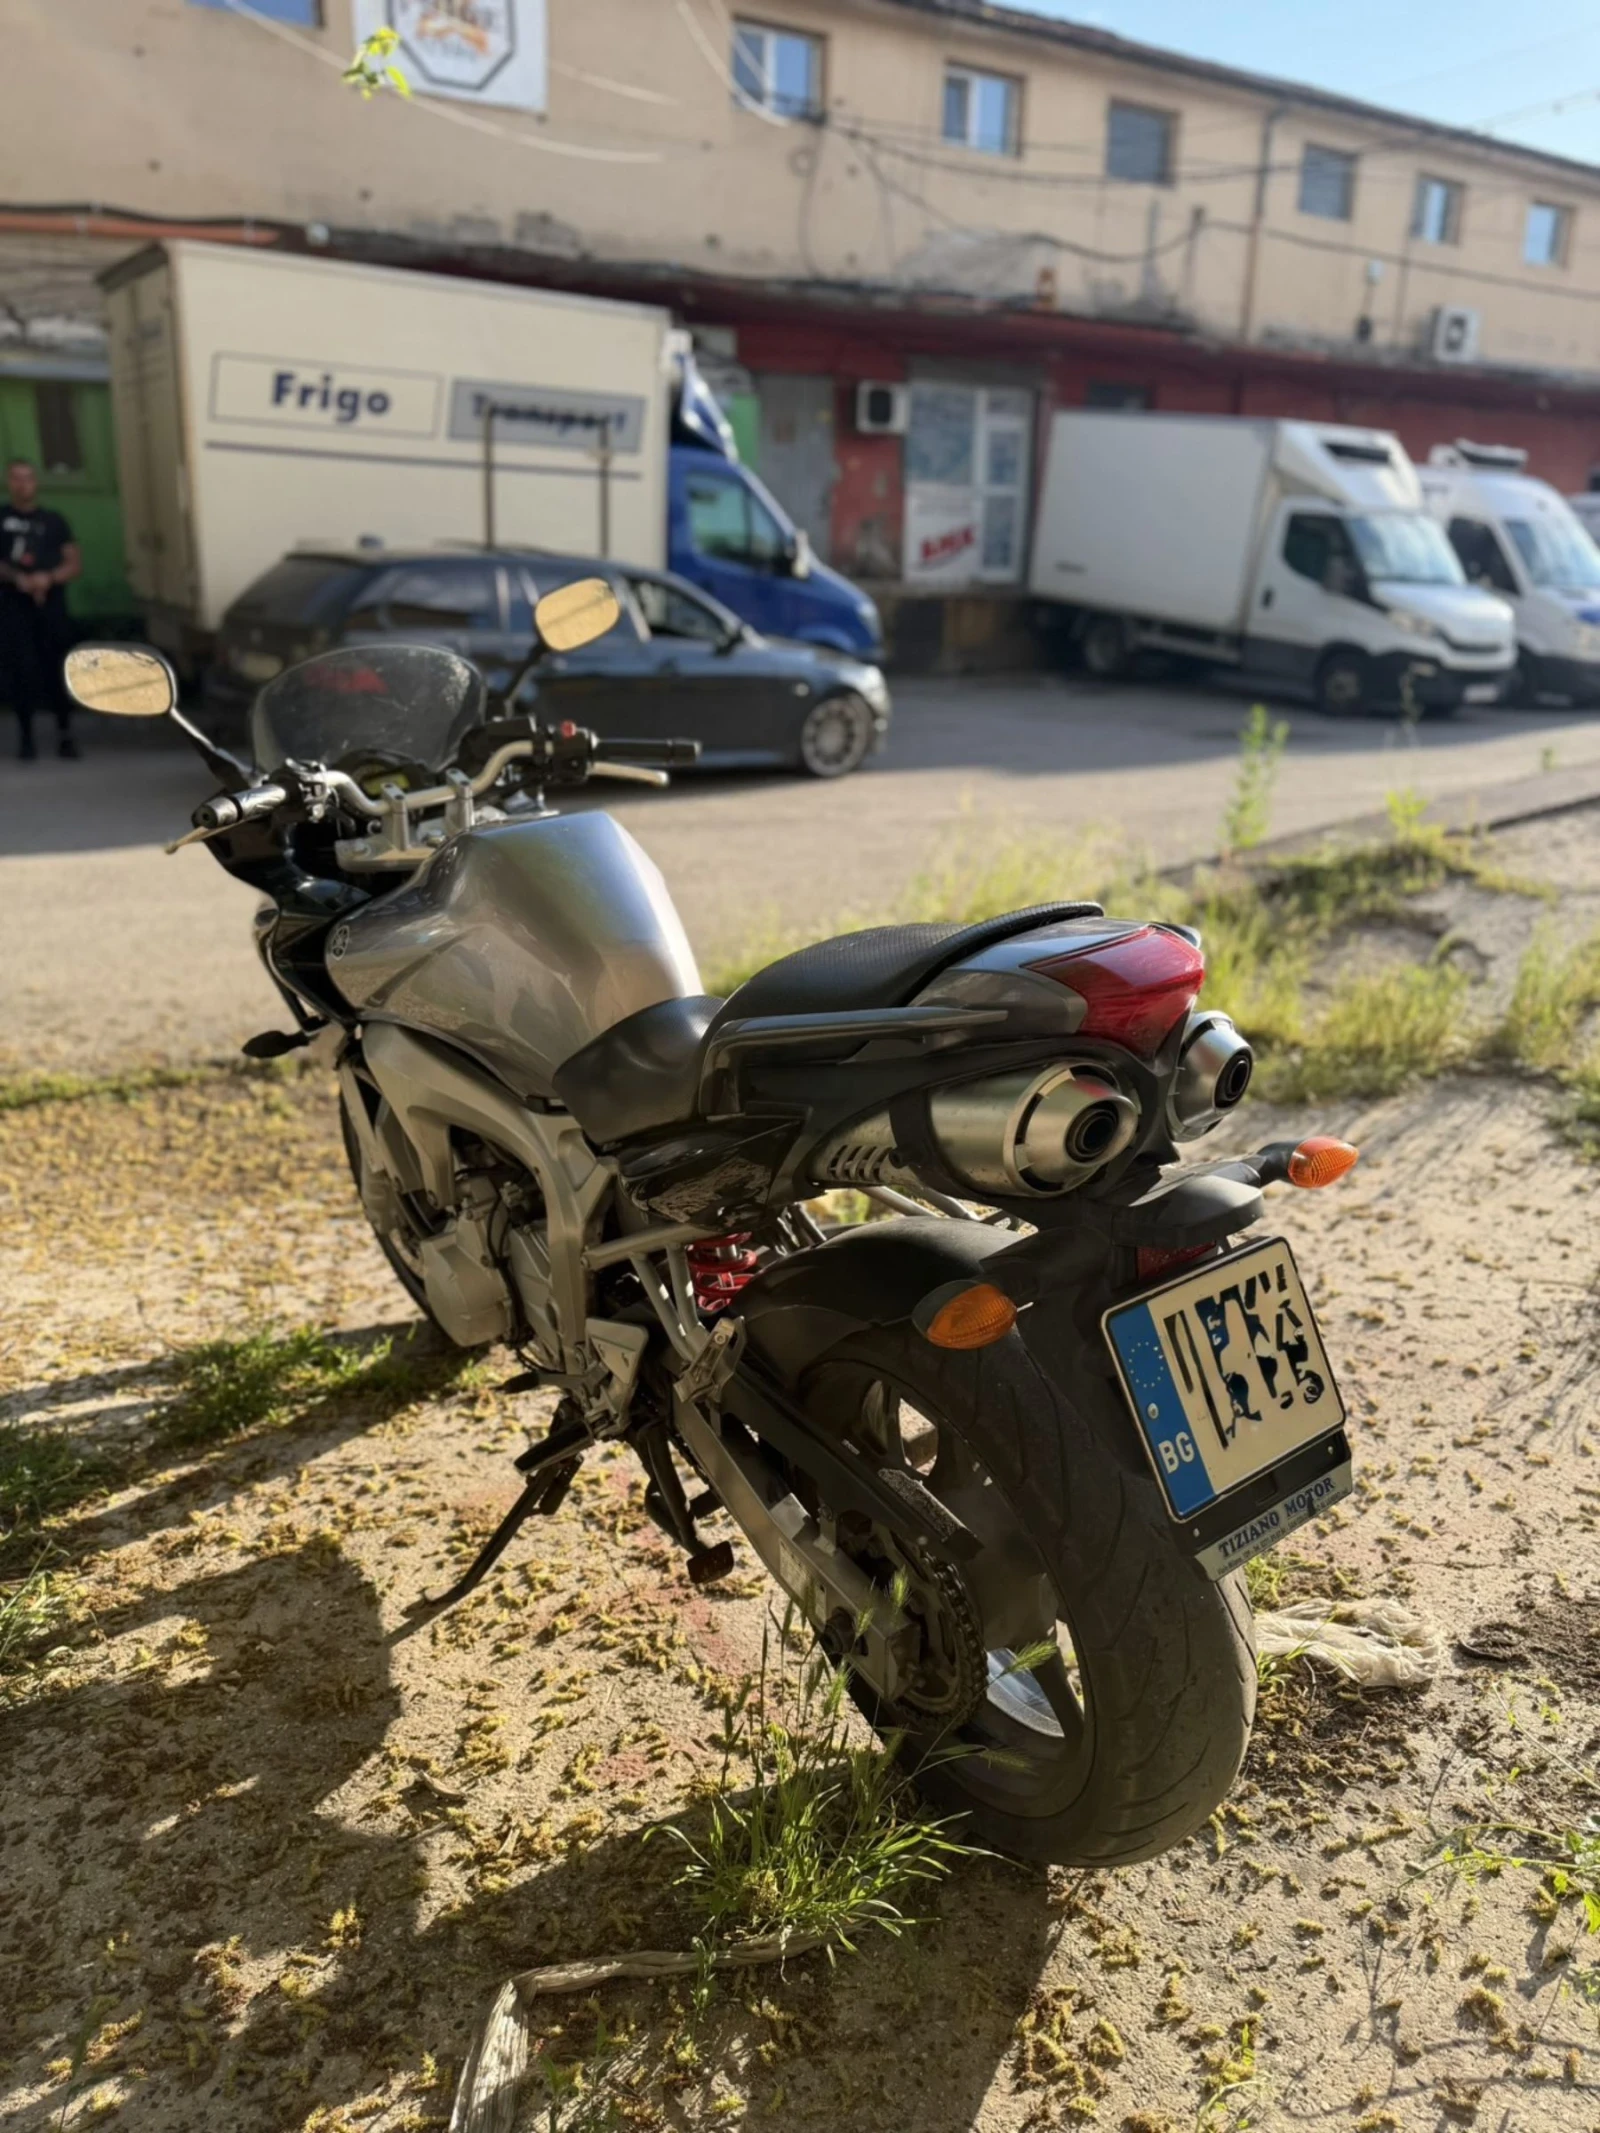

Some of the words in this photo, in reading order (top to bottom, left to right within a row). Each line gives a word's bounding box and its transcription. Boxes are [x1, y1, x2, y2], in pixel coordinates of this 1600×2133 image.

[272, 371, 391, 424] Frigo
[1158, 1431, 1194, 1474] BG
[1218, 1511, 1280, 1558] TIZIANO
[1284, 1477, 1335, 1517] MOTOR
